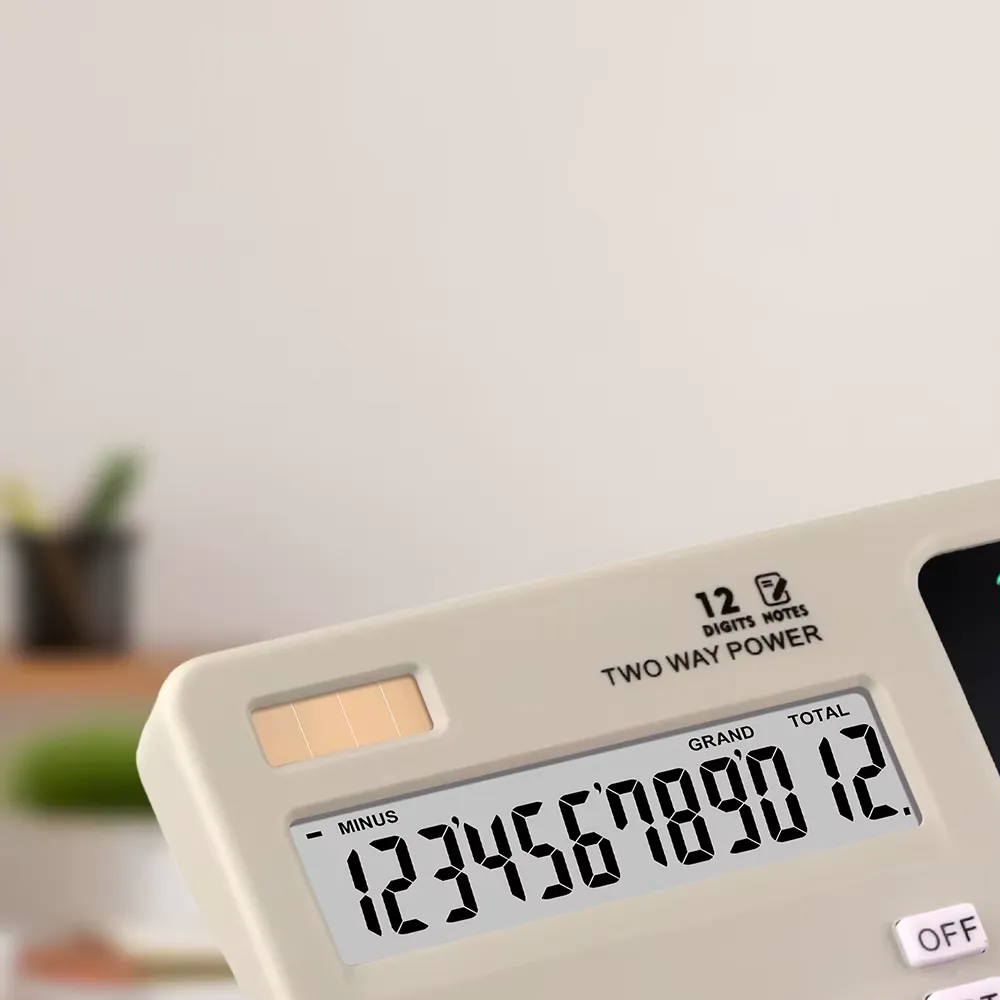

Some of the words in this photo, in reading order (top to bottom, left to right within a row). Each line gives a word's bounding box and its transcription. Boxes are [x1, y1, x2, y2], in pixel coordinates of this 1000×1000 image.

[694, 586, 741, 619] 12
[702, 615, 756, 638] DIGITS
[761, 604, 809, 625] NOTES
[600, 658, 663, 686] TWO
[665, 644, 719, 673] WAY
[726, 624, 823, 661] POWER
[687, 724, 756, 752] GRAND
[787, 703, 851, 728] TOTAL
[337, 808, 400, 835] MINUS
[918, 915, 978, 952] OFF
